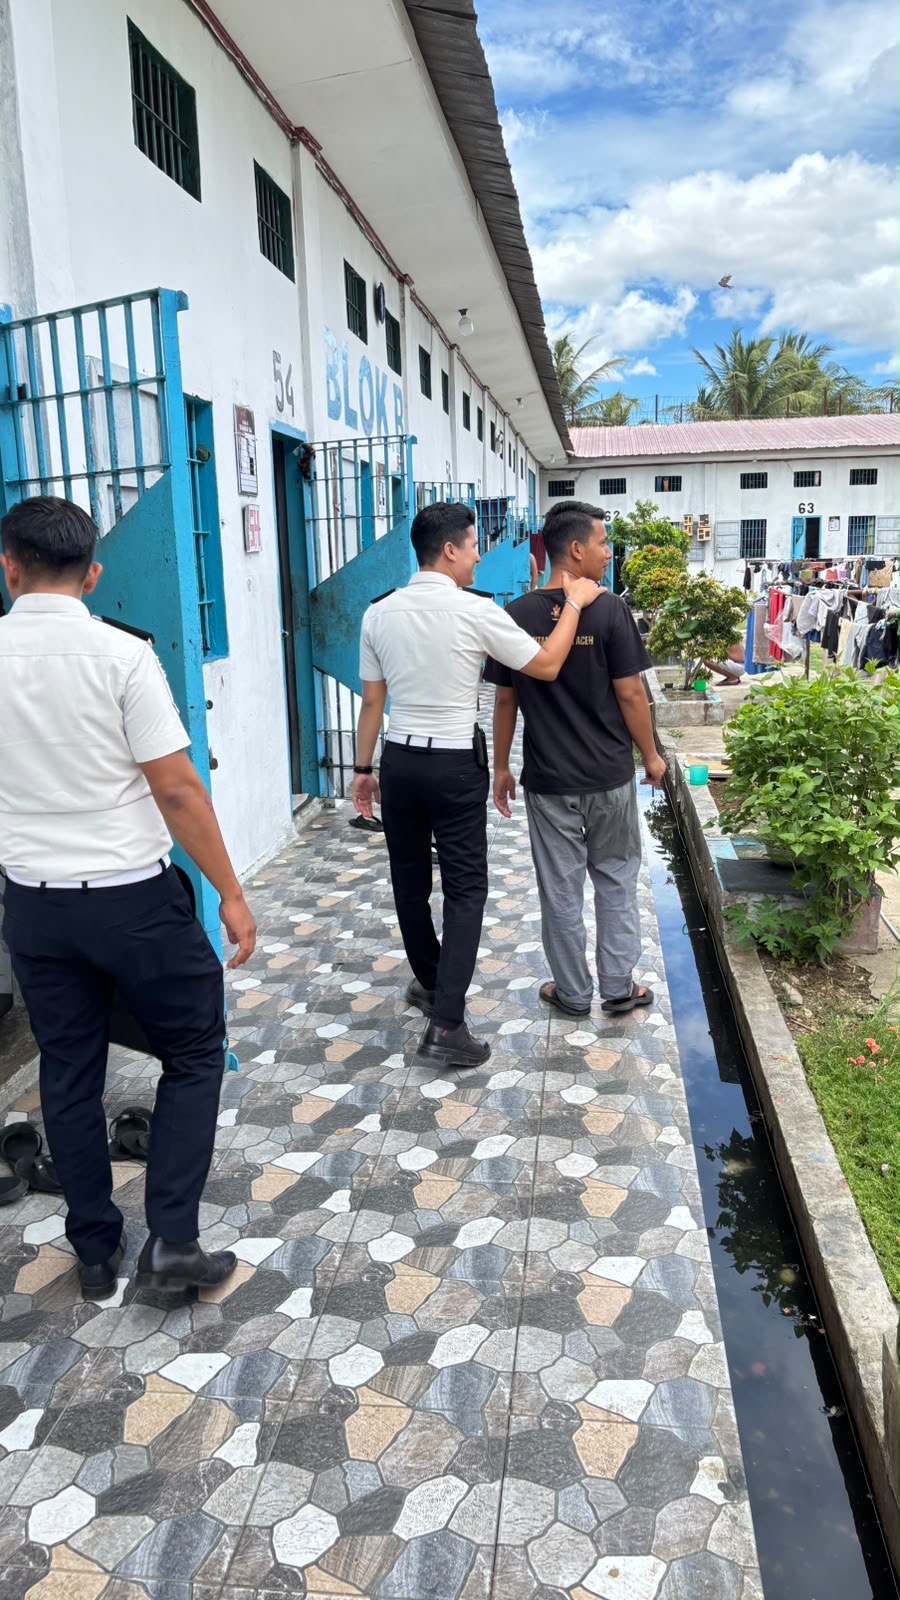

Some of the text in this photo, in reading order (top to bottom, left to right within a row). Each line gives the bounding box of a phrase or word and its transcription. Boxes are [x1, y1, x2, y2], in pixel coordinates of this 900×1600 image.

[273, 349, 295, 418] 54
[324, 325, 389, 442] BLOK
[798, 502, 815, 514] 63
[575, 635, 594, 646] ACEH
